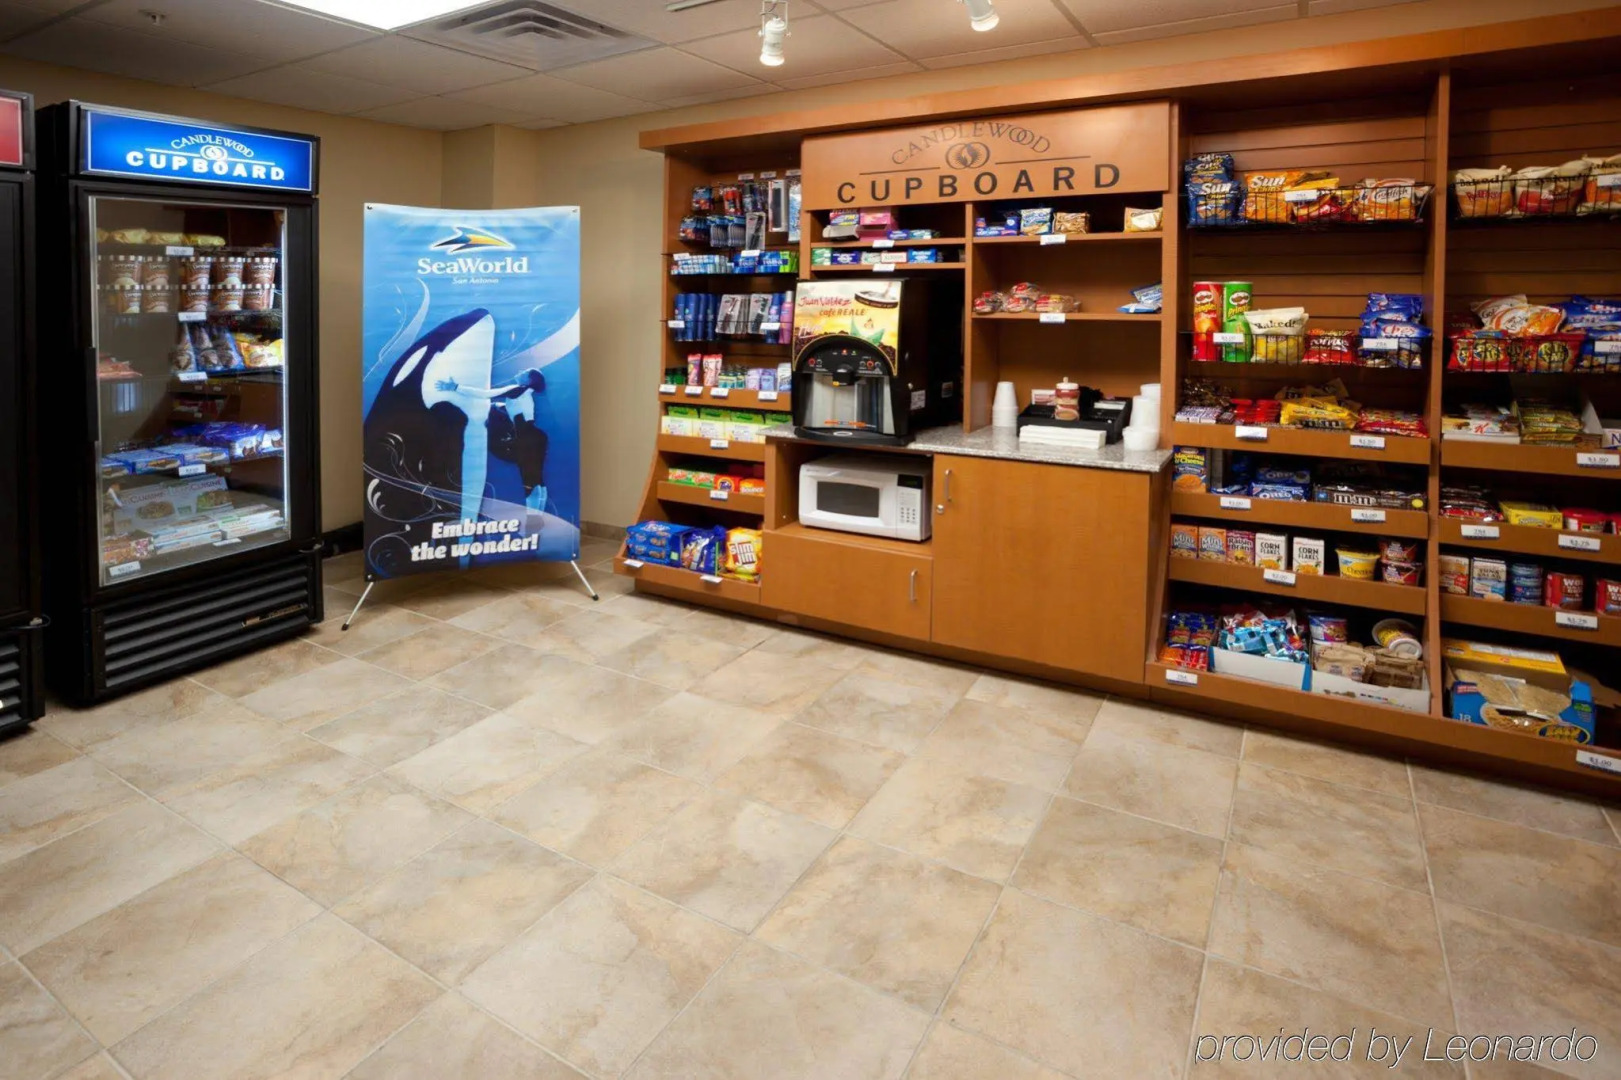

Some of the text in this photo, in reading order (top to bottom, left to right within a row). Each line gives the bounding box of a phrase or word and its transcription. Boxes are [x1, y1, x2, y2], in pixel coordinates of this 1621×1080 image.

[170, 133, 255, 158] CANDLEWOOD
[891, 121, 1051, 165] CANDLEWOOD
[126, 150, 285, 181] CUPBOARD
[837, 163, 1121, 204] CUPBOARD
[1201, 183, 1232, 194] Sun
[1252, 175, 1286, 188] Sun
[417, 257, 528, 275] SeaWorld
[1259, 492, 1292, 500] OREO
[431, 518, 521, 539] Embrace
[410, 533, 540, 562] the wonder!
[1228, 537, 1253, 546] Raisin
[1260, 541, 1280, 549] CORN
[1298, 547, 1319, 555] CORN
